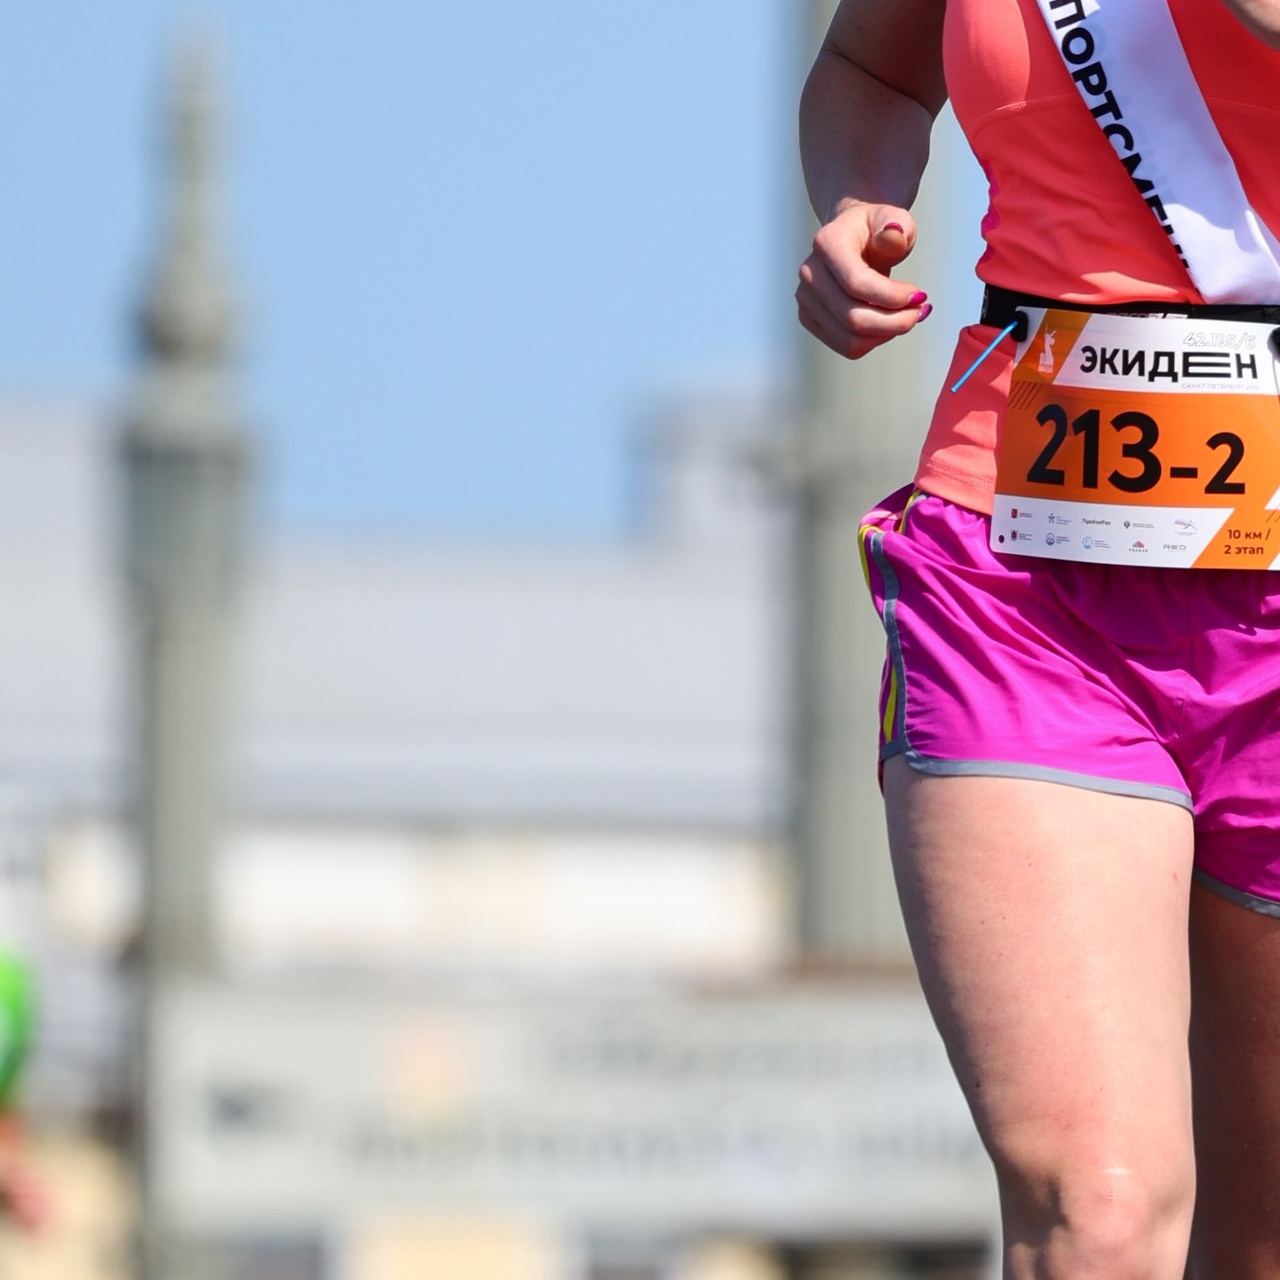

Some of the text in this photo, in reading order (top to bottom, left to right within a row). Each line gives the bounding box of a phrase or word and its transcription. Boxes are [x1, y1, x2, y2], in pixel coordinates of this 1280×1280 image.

[1182, 331, 1256, 351] 42.195/6
[1080, 345, 1258, 383] ЭКИДЕН
[1026, 404, 1246, 495] 213-2
[1228, 529, 1241, 540] 10
[1244, 531, 1262, 540] км
[1224, 545, 1264, 555] 2 этап
